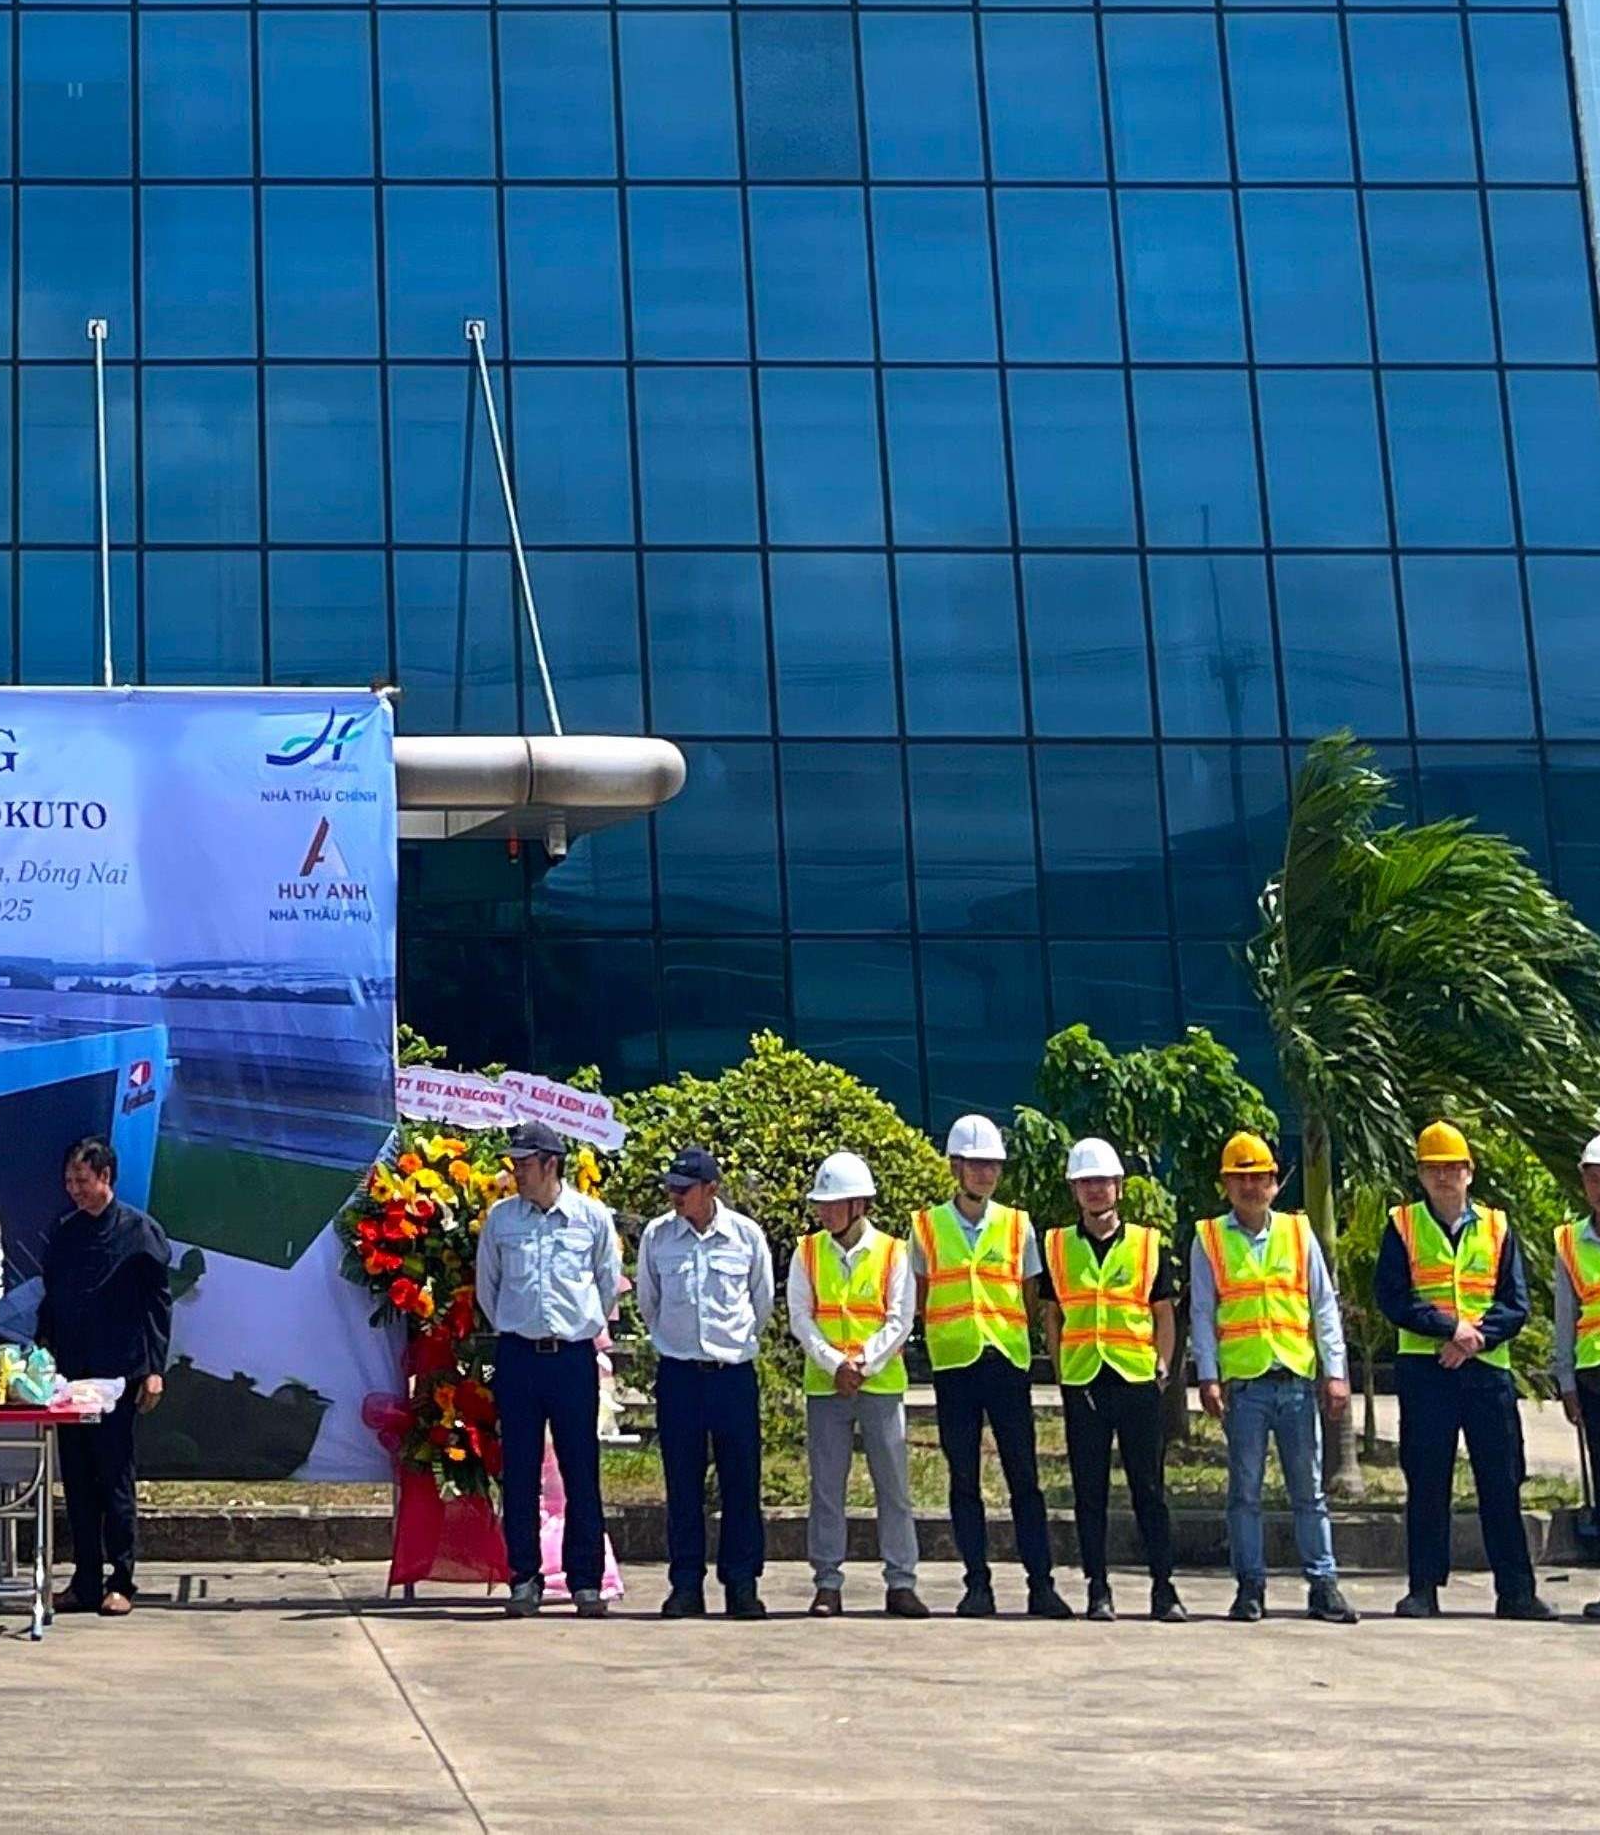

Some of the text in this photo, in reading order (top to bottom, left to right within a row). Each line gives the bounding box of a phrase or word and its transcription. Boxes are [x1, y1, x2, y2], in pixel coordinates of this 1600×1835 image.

[86, 860, 130, 885] Nai
[278, 883, 367, 900] HUY ANH
